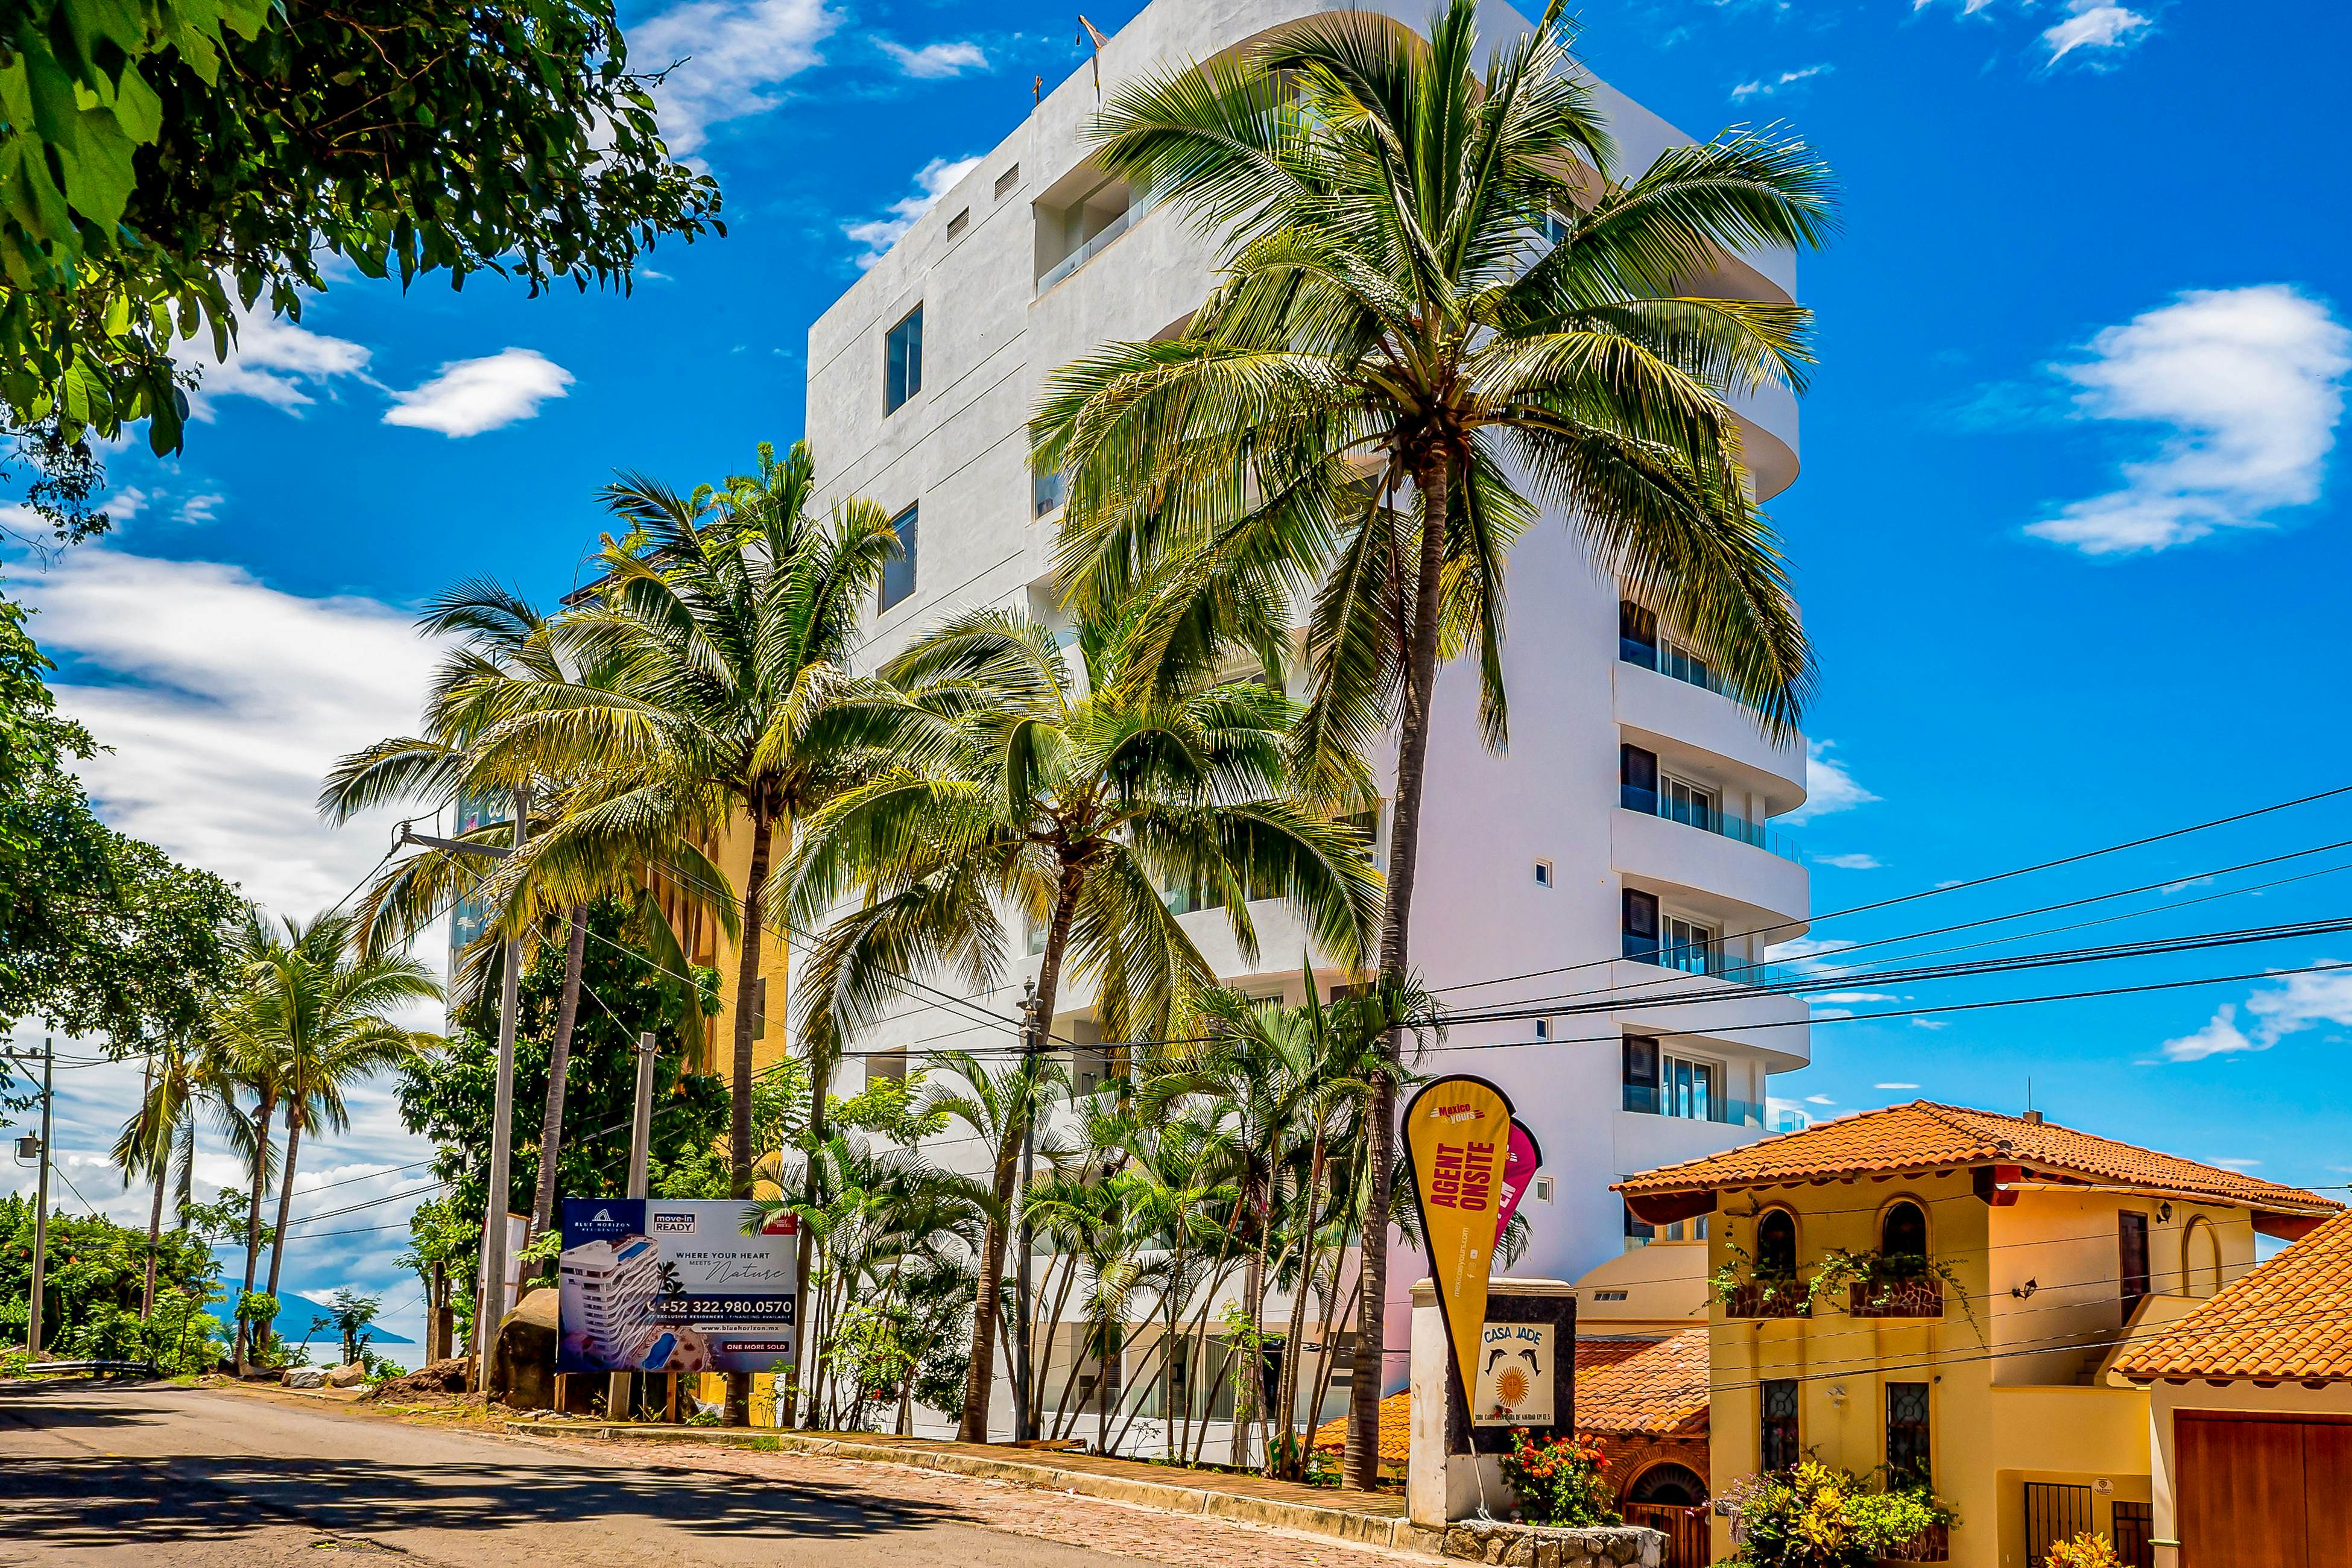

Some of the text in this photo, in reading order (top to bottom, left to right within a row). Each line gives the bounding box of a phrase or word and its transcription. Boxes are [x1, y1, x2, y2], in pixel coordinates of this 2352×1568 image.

[1438, 1104, 1470, 1116] Mexico
[1450, 1112, 1476, 1124] yours
[1430, 1143, 1464, 1209] AGENT
[1459, 1142, 1494, 1211] ONSITE
[705, 1260, 785, 1283] Nature
[1454, 1227, 1469, 1297] mexicoisyours.com
[660, 1301, 792, 1313] +52 322.980.0570
[1484, 1326, 1543, 1346] CASA JADE
